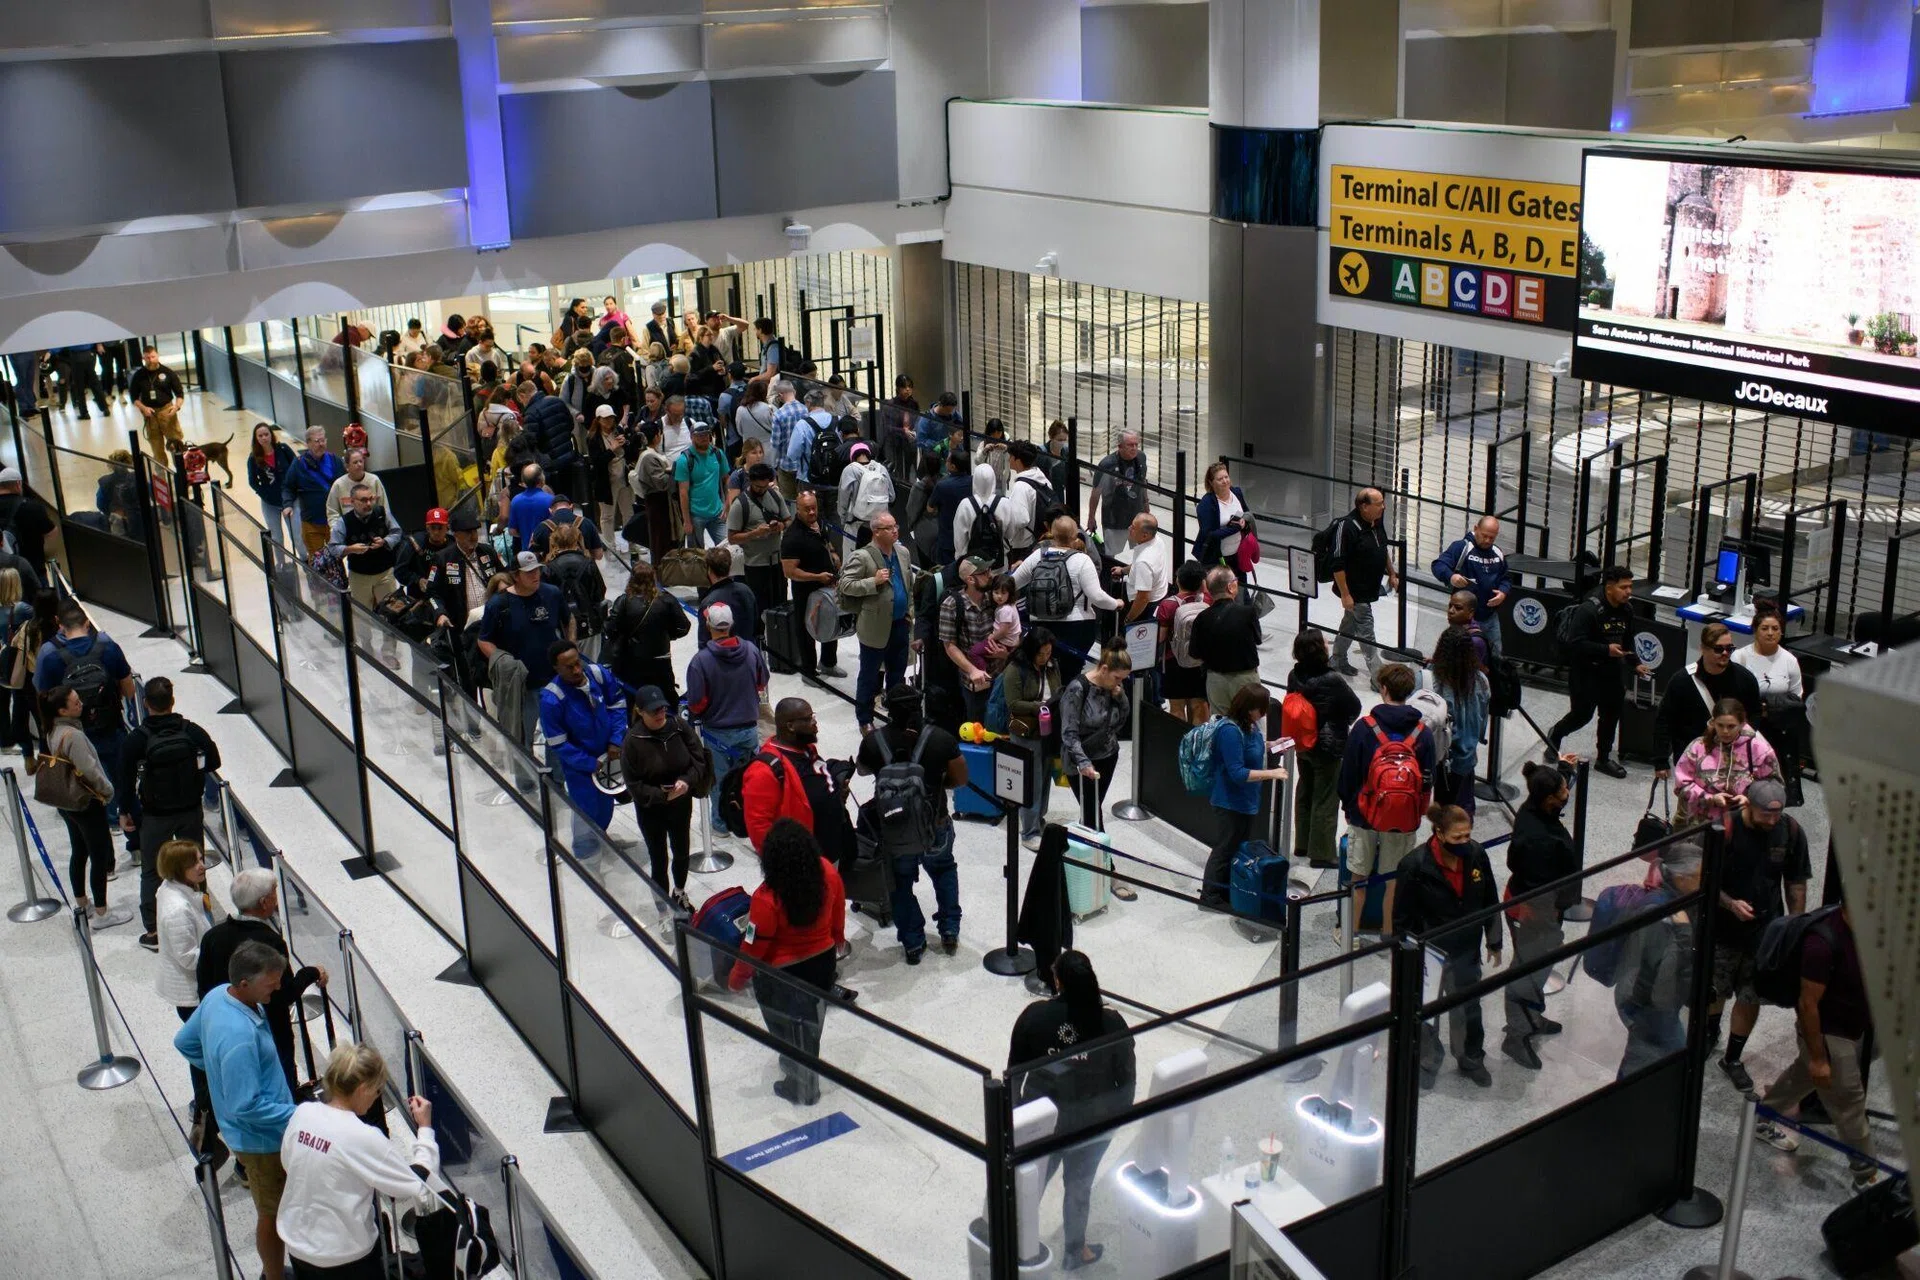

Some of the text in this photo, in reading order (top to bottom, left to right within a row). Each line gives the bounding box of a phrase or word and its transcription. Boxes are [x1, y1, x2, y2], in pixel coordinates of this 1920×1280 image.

[1340, 174, 1580, 222] Terminal C/All Gates
[1340, 215, 1575, 268] Terminals A, B, D, E
[1395, 263, 1539, 311] A B C D E
[1454, 301, 1477, 310] TERMINAL
[1484, 305, 1508, 315] TERMINAL
[1516, 310, 1541, 319] TERMINAL
[1592, 324, 1810, 368] San Antonio Missions National Historical Park
[1735, 381, 1829, 413] JCDecaux
[1006, 778, 1013, 790] 3
[1047, 1047, 1088, 1060] CAR
[298, 1130, 331, 1154] BRAUN
[782, 1134, 808, 1144] Please
